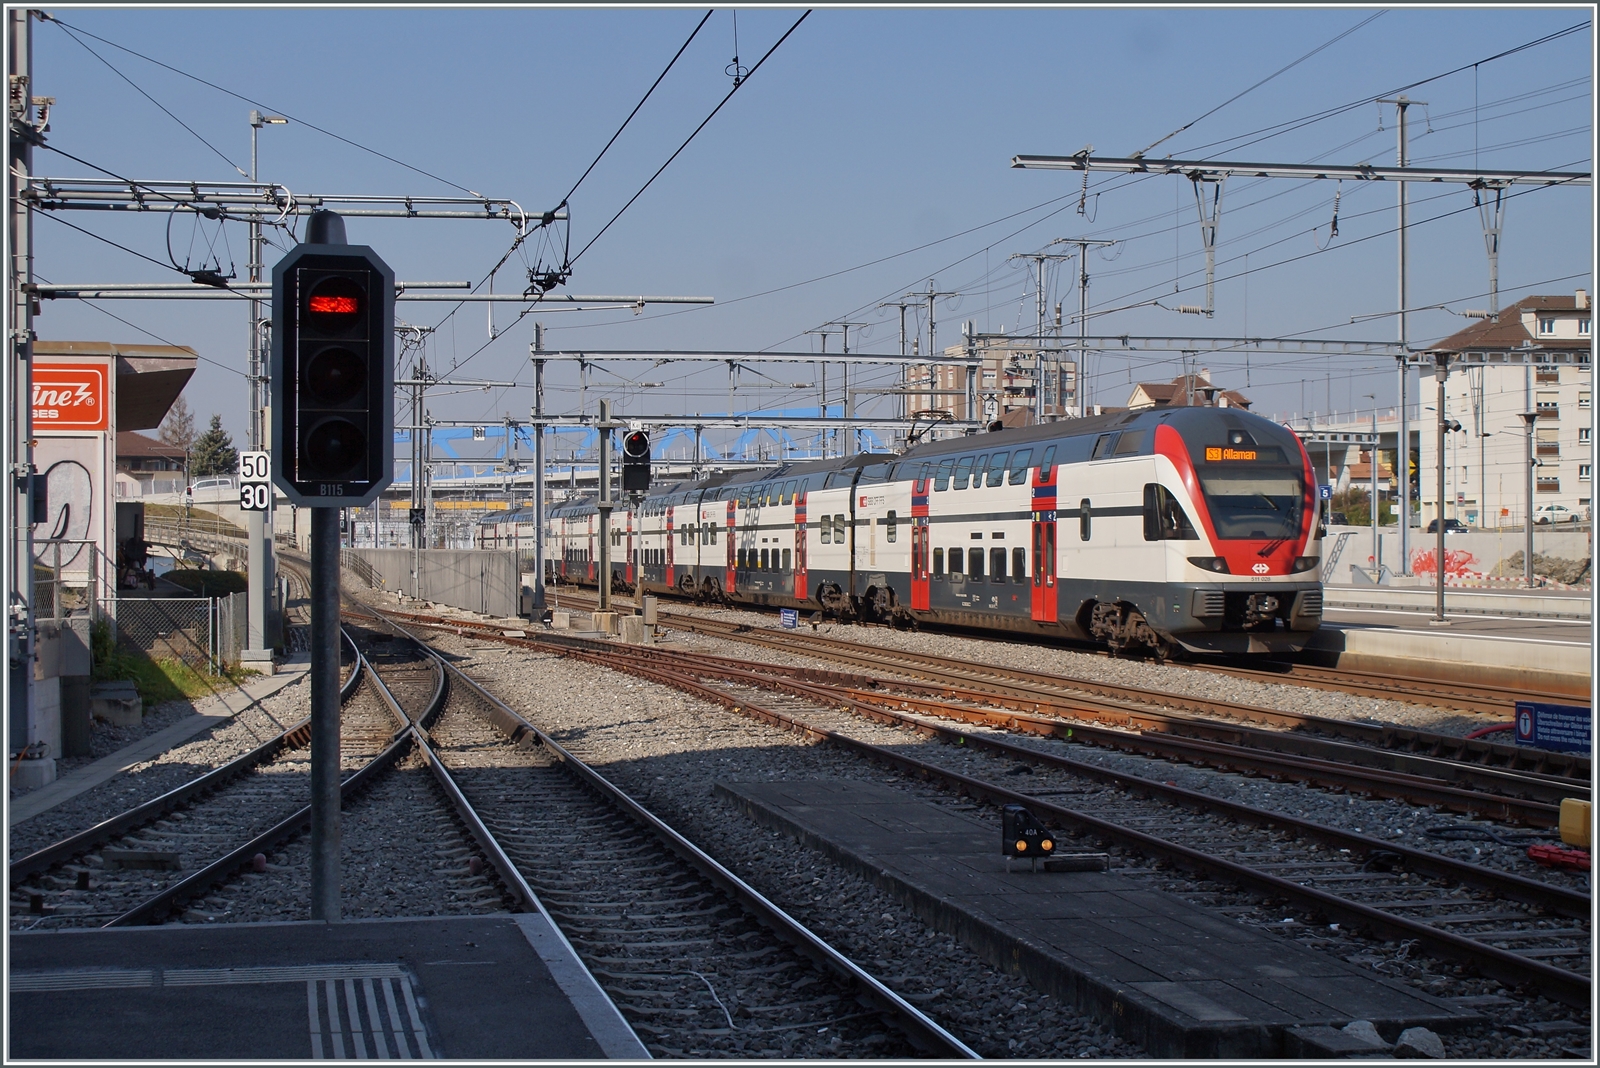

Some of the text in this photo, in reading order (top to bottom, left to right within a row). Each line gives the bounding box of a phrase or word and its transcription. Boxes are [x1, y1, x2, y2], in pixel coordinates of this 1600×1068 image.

[32, 385, 72, 406] ine
[1208, 448, 1256, 460] S3 Allaman
[242, 455, 268, 478] 50
[241, 484, 269, 509] 30
[320, 484, 343, 496] B115
[1322, 489, 1329, 498] 5
